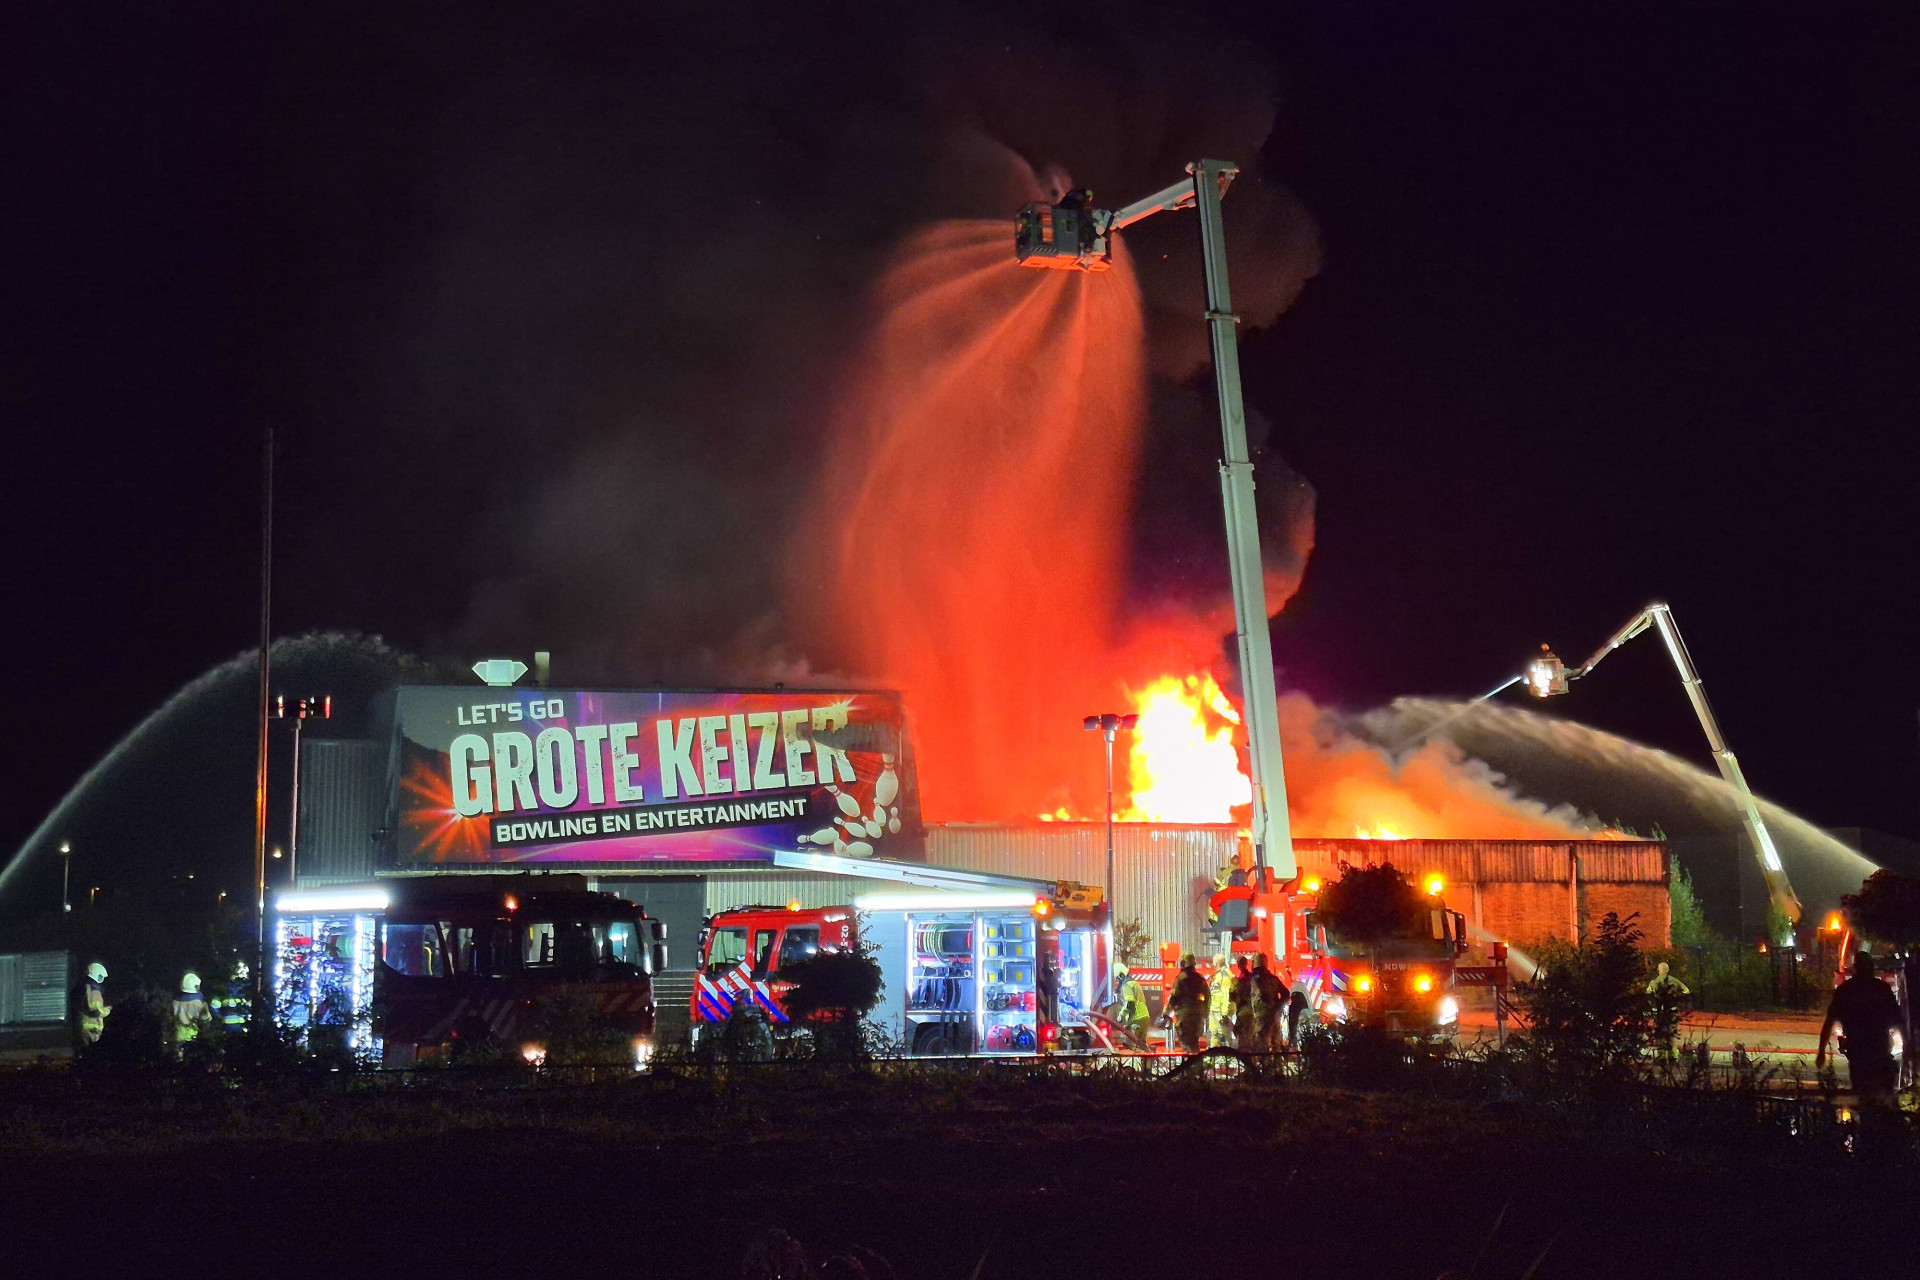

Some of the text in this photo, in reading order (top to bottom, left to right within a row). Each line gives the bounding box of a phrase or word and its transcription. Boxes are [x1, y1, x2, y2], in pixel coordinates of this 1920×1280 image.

[458, 699, 565, 726] LET'S GO
[450, 704, 857, 817] GROTE KEIZER
[496, 798, 807, 843] BOWLING EN ENTERTAINMENT
[840, 925, 850, 948] 02-5
